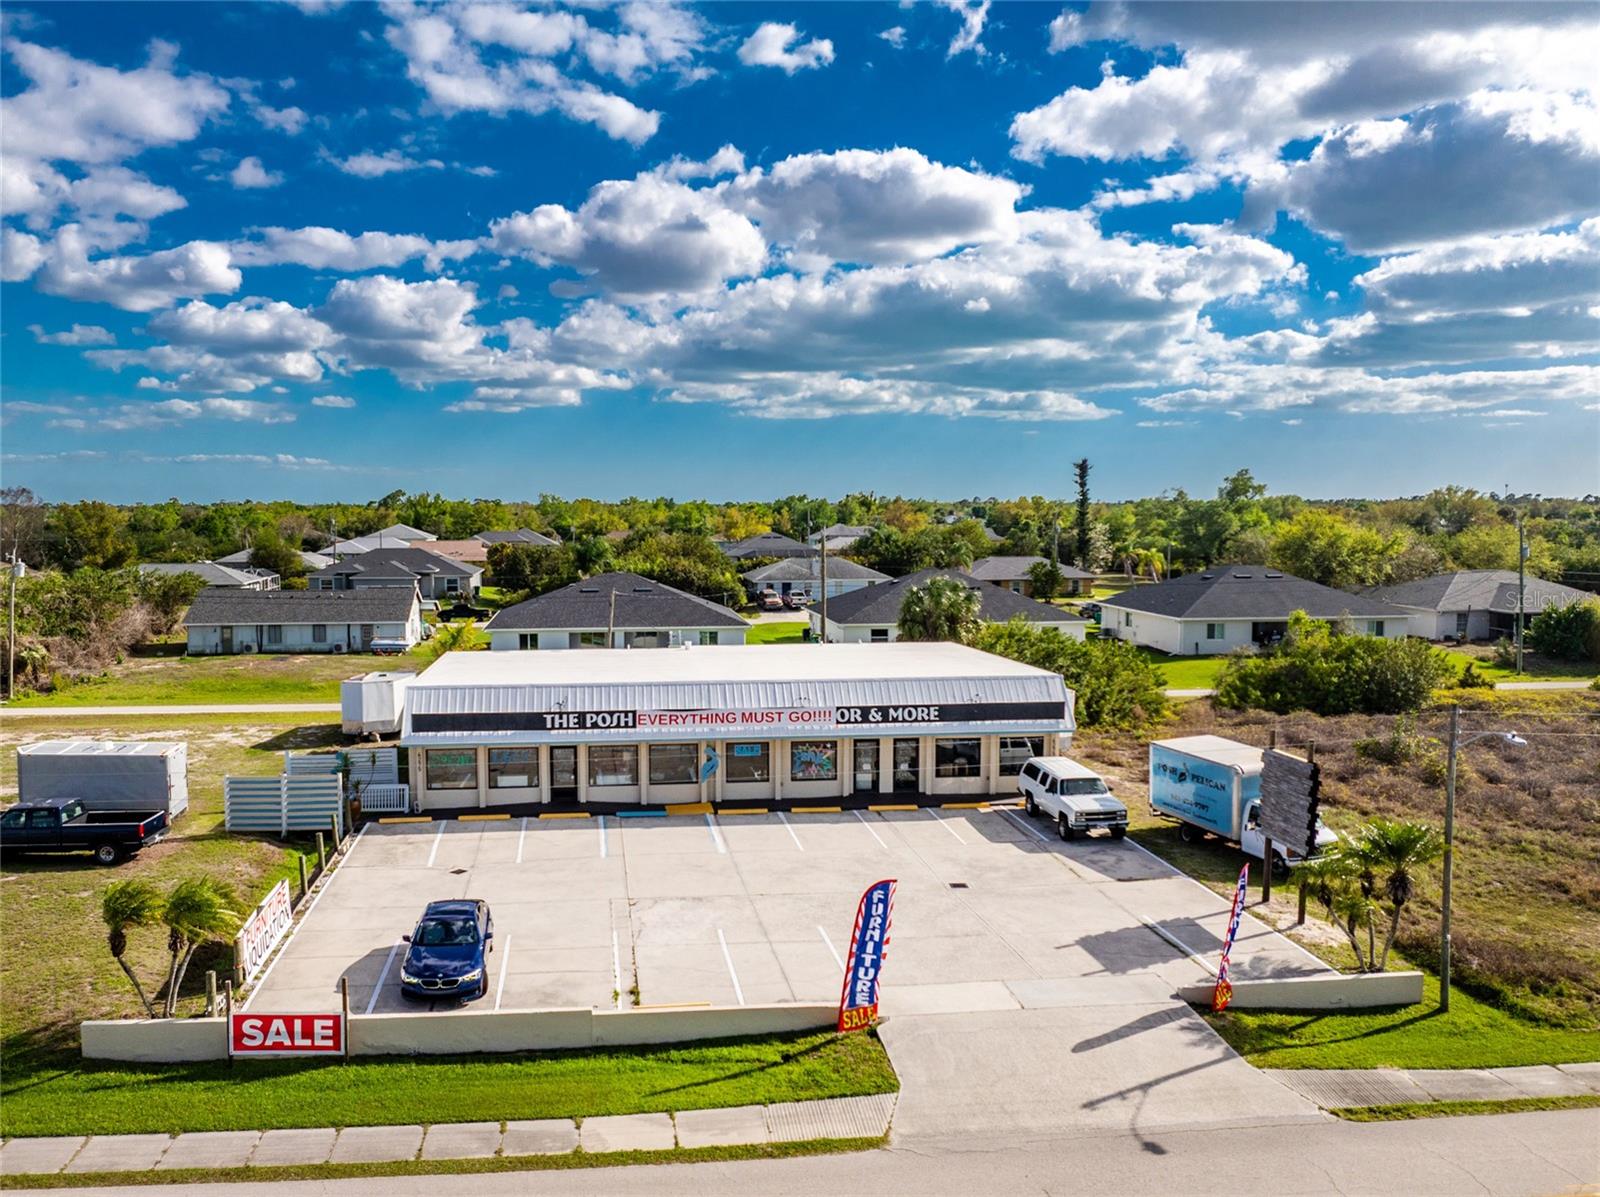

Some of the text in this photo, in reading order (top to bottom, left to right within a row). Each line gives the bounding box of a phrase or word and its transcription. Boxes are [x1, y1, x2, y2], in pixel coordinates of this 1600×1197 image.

[543, 712, 634, 729] THE POSH
[637, 710, 832, 726] EVERYTHING MUST GO!!!!
[868, 708, 883, 722] &
[888, 706, 940, 721] MORE
[1191, 773, 1226, 792] PELICAN
[242, 885, 287, 945] FURNITURE
[244, 906, 291, 978] LIQUIDATION
[855, 890, 885, 1005] FURNITURE
[842, 1006, 877, 1029] SALE
[241, 1018, 334, 1047] SALE
